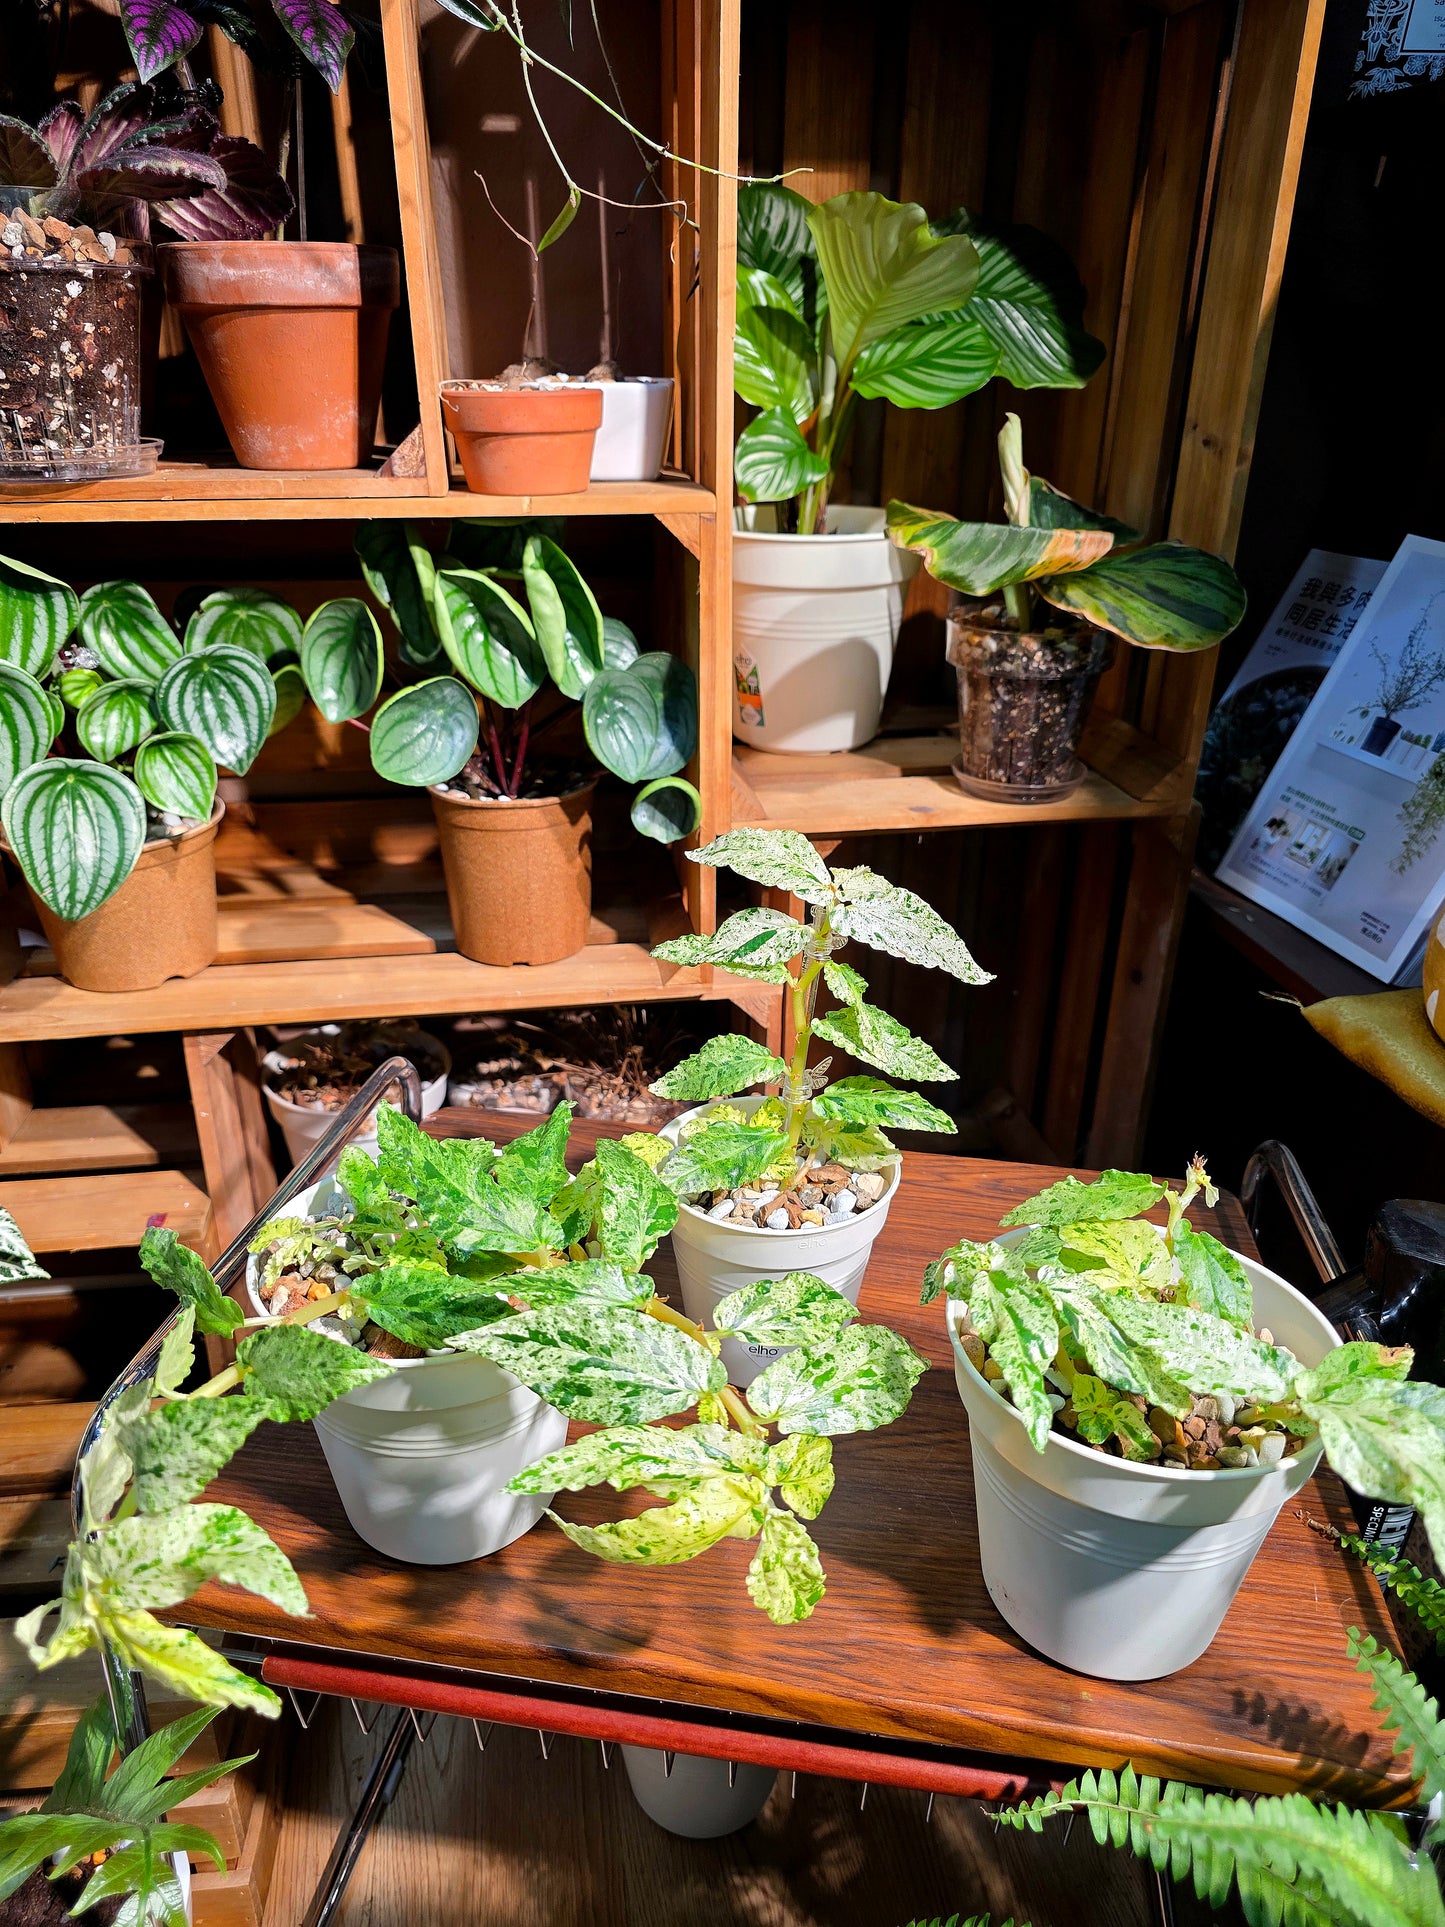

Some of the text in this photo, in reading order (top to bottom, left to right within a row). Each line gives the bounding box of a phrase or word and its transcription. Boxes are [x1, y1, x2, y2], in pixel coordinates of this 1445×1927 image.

[1299, 577, 1373, 610] 我與多肉
[1283, 602, 1358, 640] 同居生活
[748, 1345, 778, 1356] elho
[1363, 1506, 1385, 1546] SPECIME
